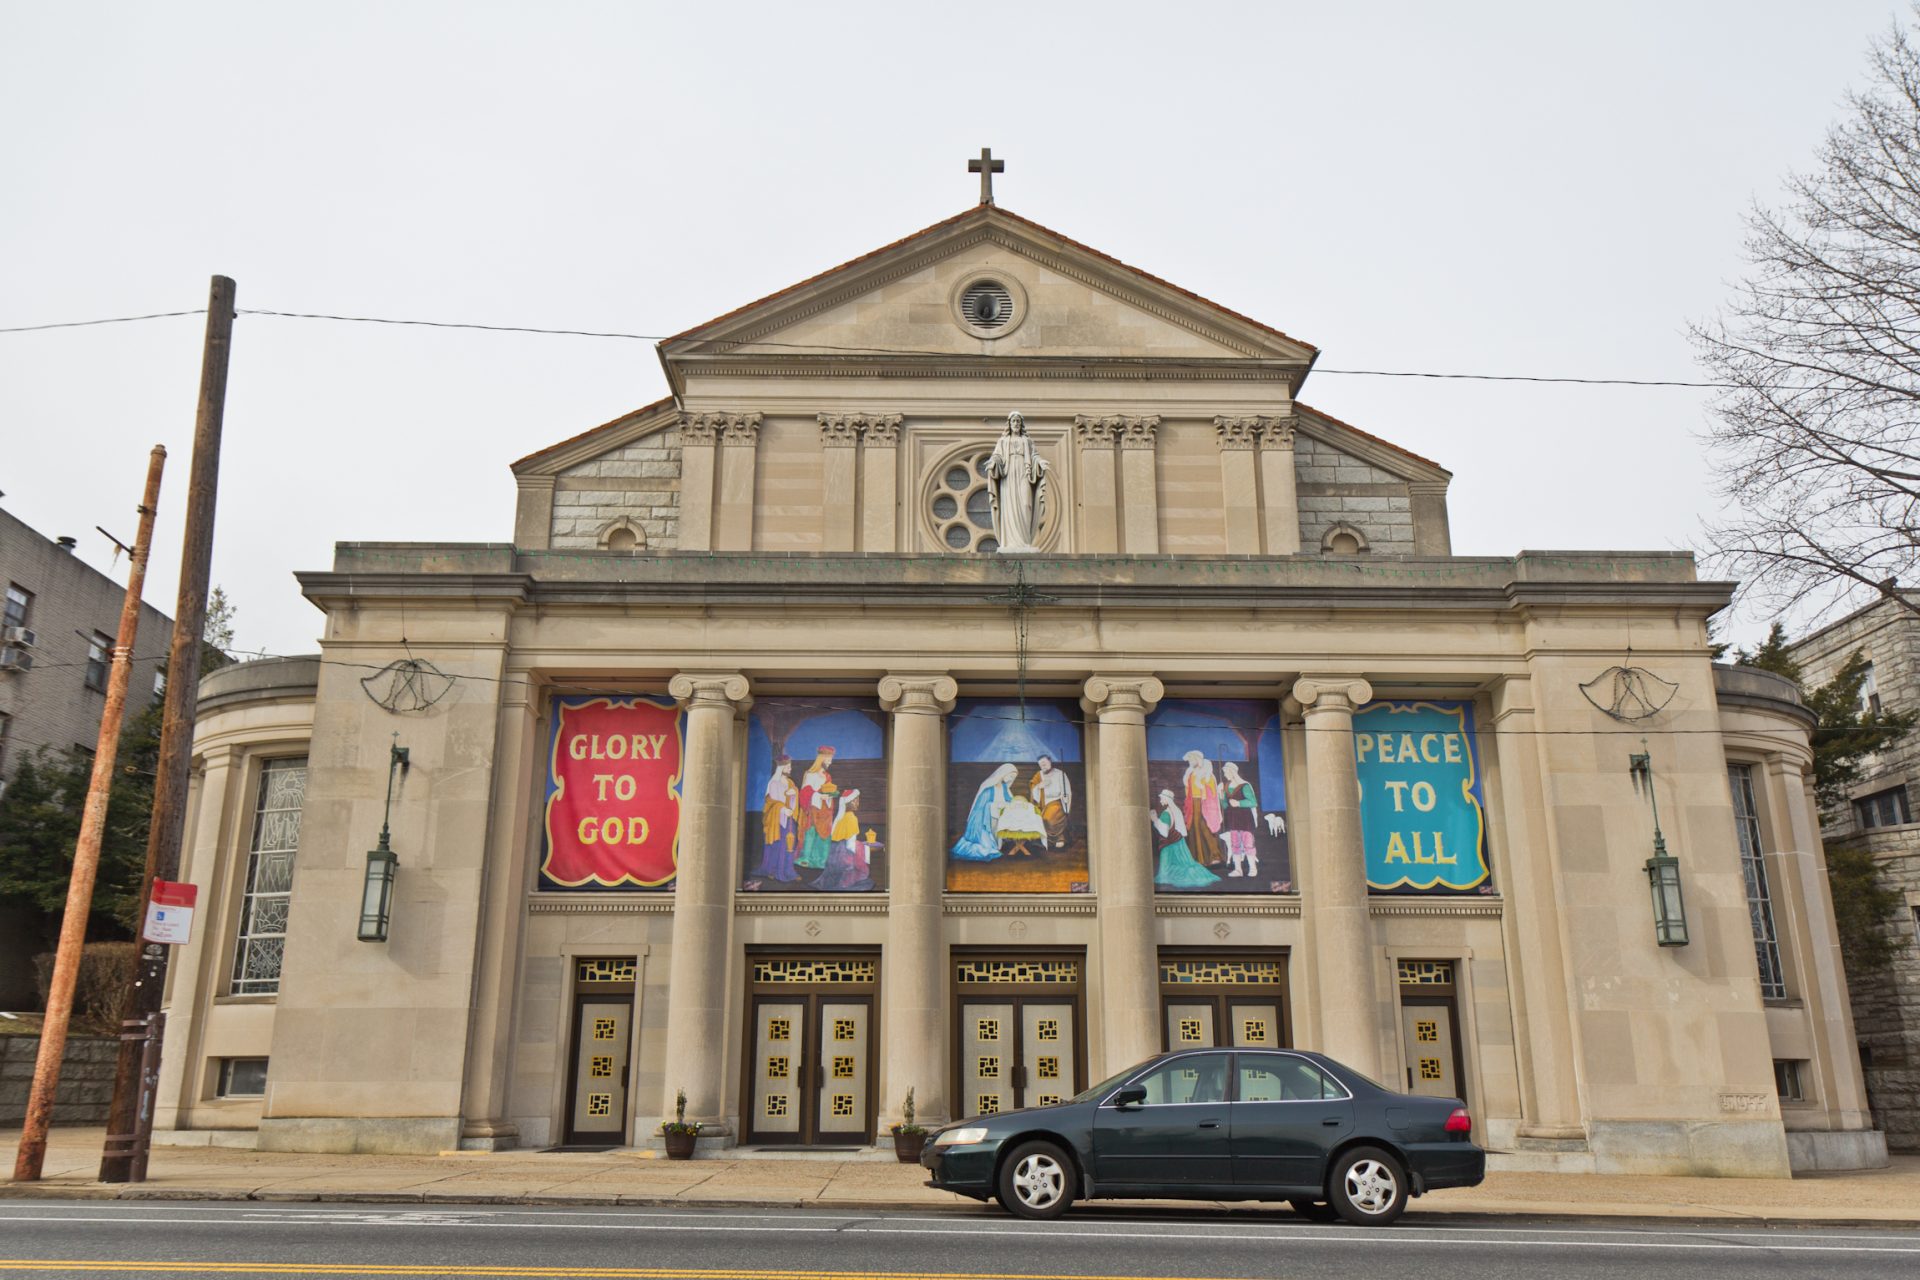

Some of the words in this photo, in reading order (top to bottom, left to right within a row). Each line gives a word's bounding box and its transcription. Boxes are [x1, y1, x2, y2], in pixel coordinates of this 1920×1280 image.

[570, 735, 666, 760] GLORY
[1357, 734, 1461, 763] PEACE
[593, 774, 637, 801] TO
[1385, 781, 1436, 812] TO
[578, 817, 649, 844] GOD
[1385, 832, 1457, 864] ALL
